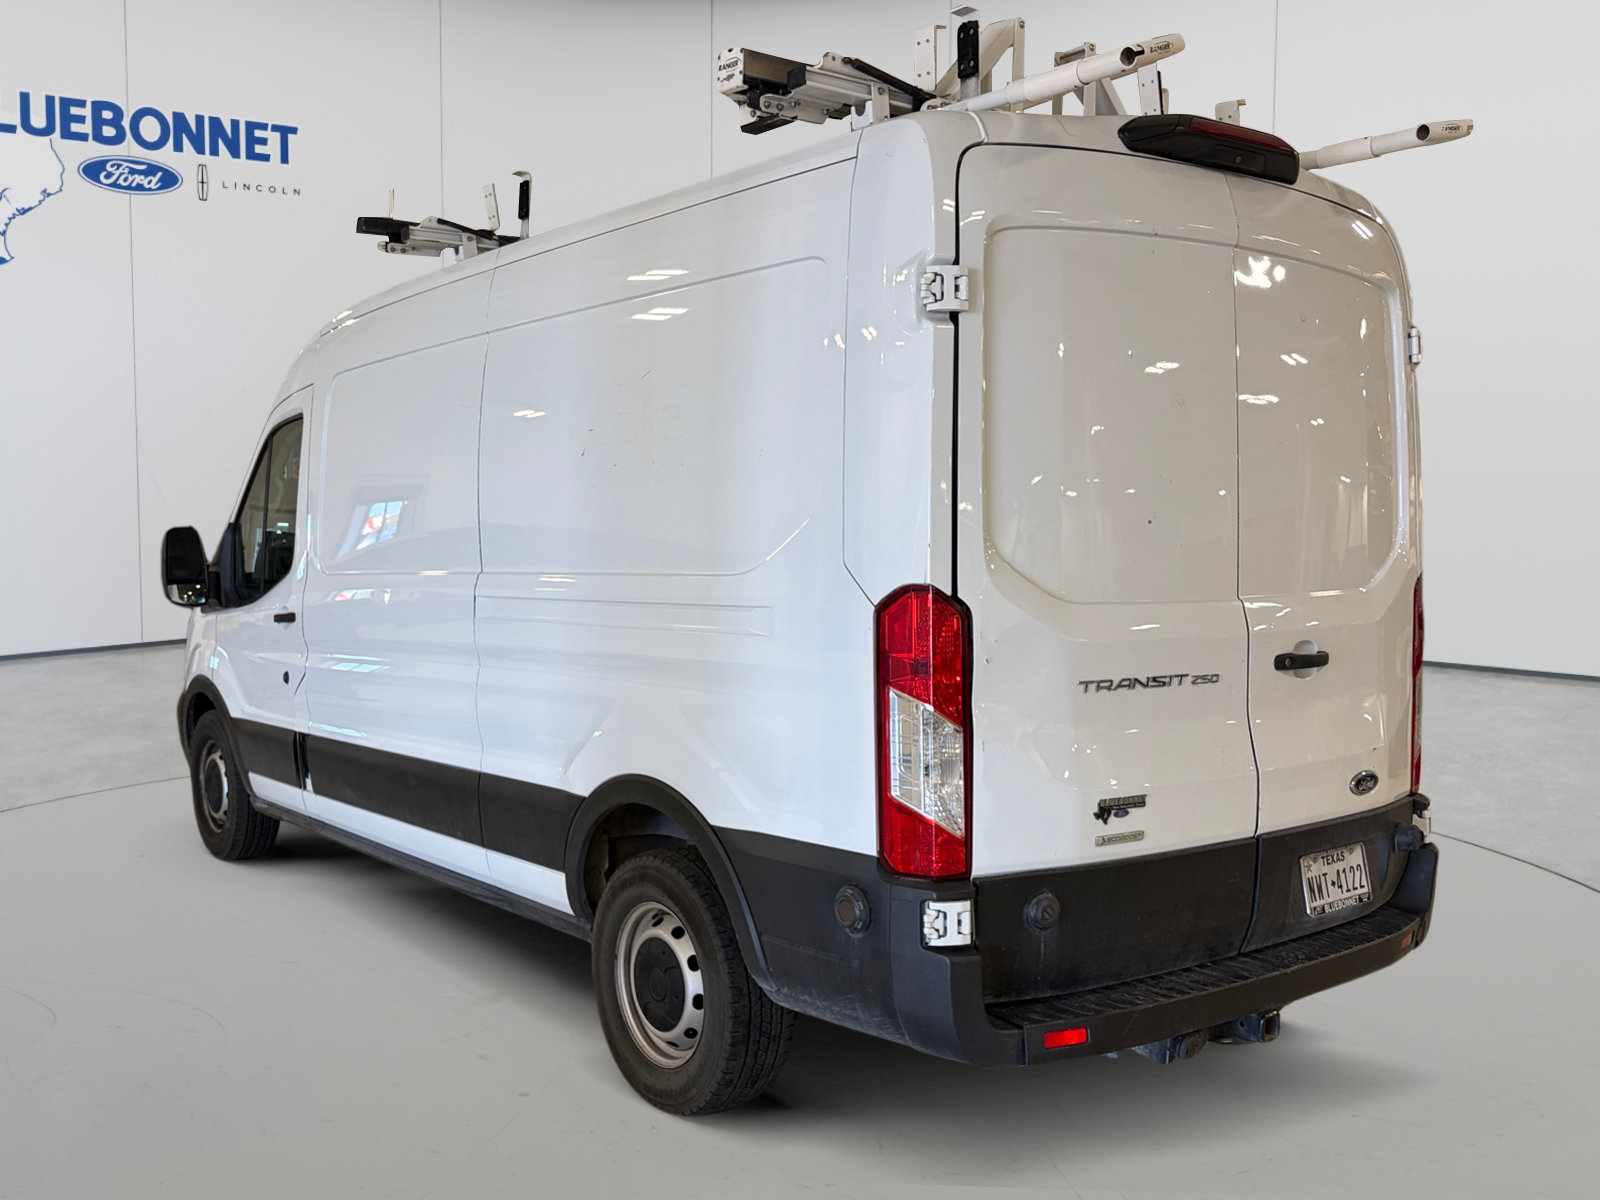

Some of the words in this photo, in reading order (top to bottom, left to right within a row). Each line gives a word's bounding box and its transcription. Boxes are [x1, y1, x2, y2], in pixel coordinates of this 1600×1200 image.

[100, 160, 163, 190] Ford
[222, 180, 301, 196] LINCOLN
[1078, 674, 1189, 694] TRANSIT
[1191, 673, 1219, 685] 250
[1321, 851, 1345, 866] TEXAS
[1324, 895, 1360, 913] BLUEBONNET
